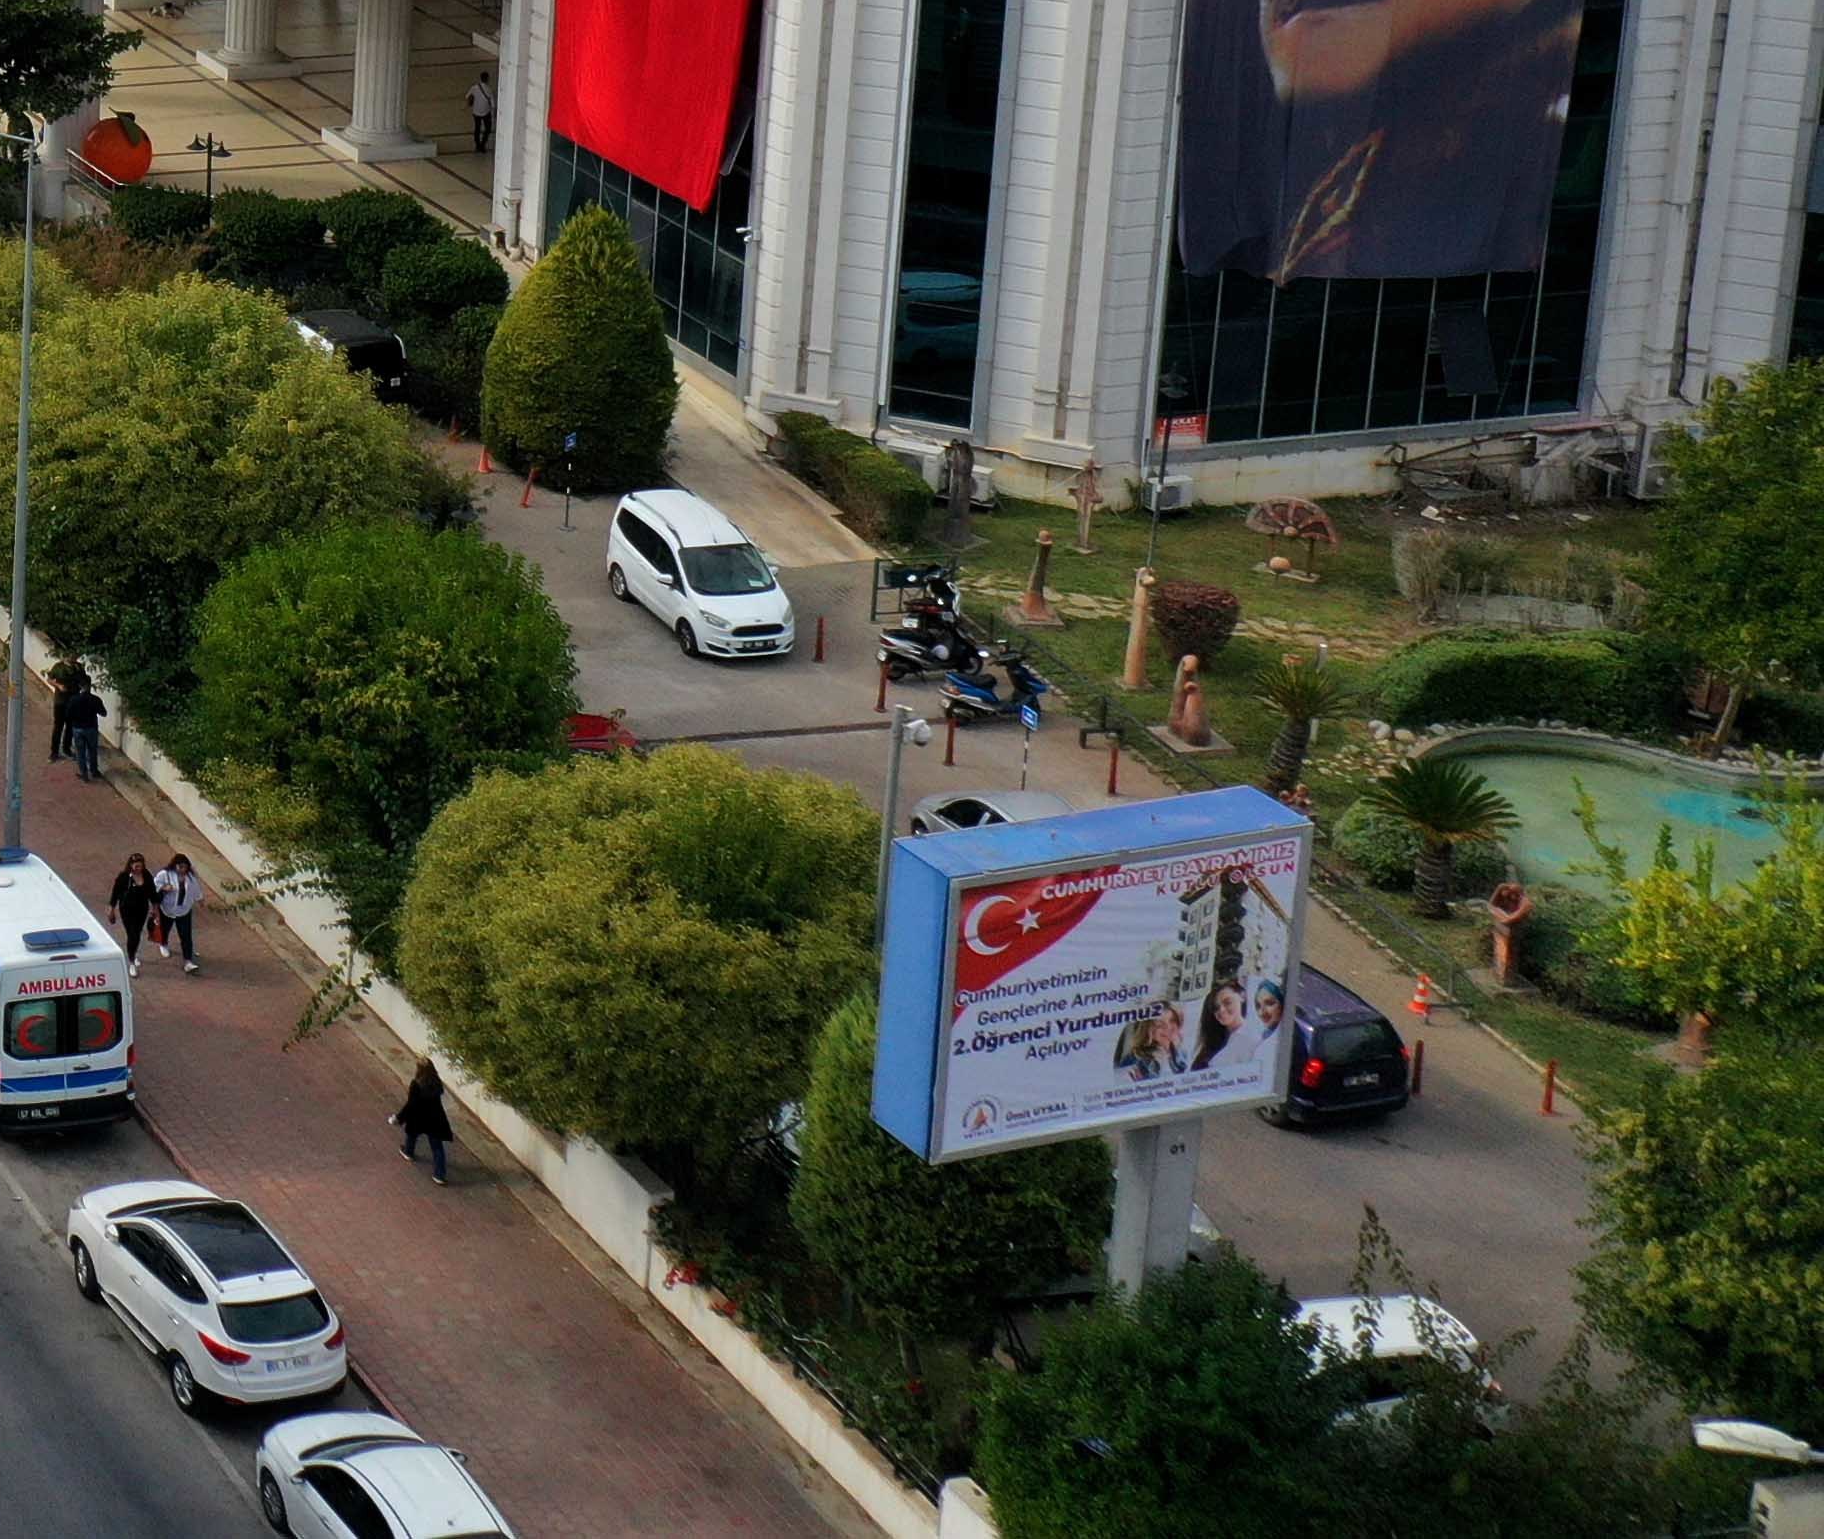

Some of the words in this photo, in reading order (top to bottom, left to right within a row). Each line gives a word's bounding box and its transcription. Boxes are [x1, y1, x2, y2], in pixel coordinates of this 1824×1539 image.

[1041, 866, 1169, 901] CUMHURİYET
[1172, 841, 1297, 881] BAYRAMIMIZ
[1228, 860, 1297, 886] OLSUN
[17, 973, 107, 995] AMBULANS
[955, 966, 1109, 1008] Cumhuriyetimizin
[977, 998, 1067, 1028] Gençlerine
[1071, 982, 1150, 1009] Armağan
[953, 1019, 1053, 1058] 2.Öğrenci
[1054, 1001, 1164, 1037] Yurdumuz
[1024, 1036, 1093, 1062] Açılıyor
